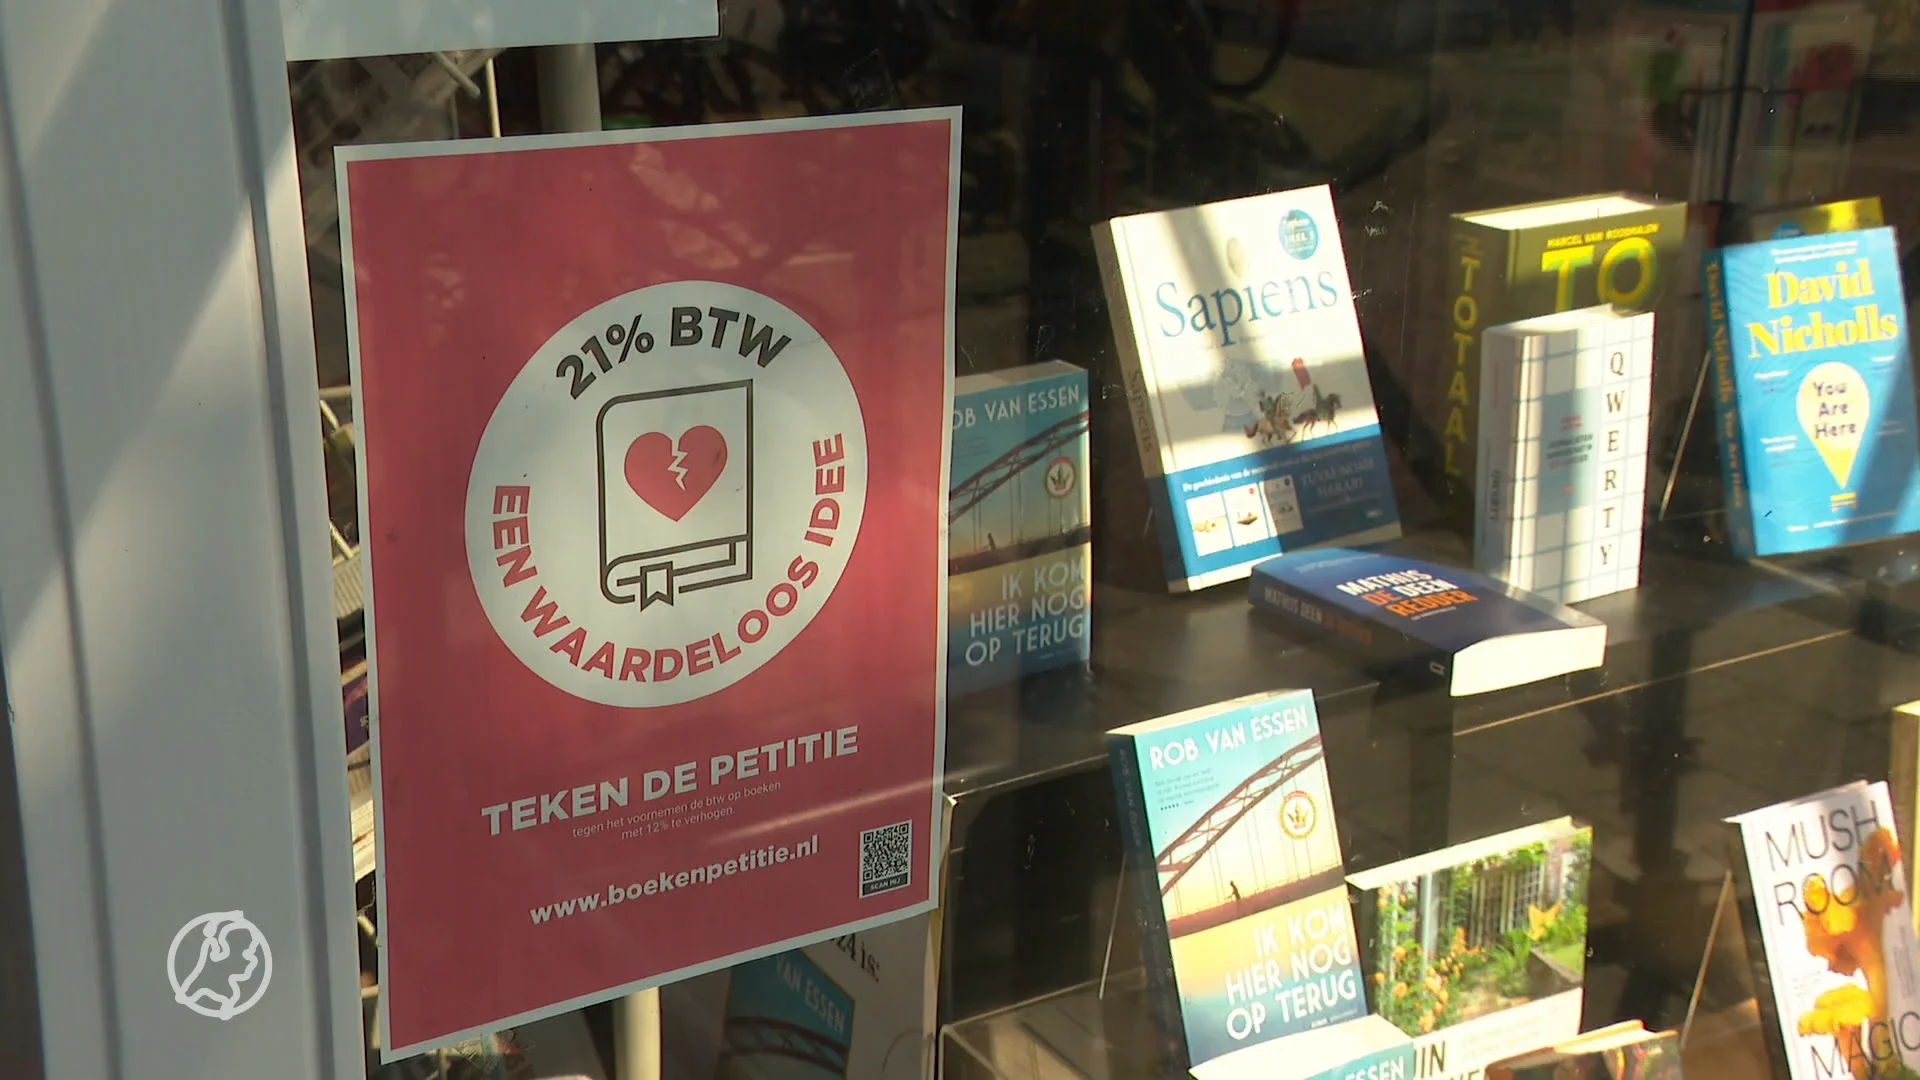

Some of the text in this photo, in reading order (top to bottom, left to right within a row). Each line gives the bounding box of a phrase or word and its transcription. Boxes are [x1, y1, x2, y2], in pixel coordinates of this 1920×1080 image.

[1542, 237, 1658, 312] TO
[1765, 258, 1875, 309] David
[1155, 270, 1338, 348] Sapiens
[1744, 303, 1899, 359] Nicholls
[555, 306, 793, 400] 21% BTW
[1445, 255, 1482, 477] TOTAAL
[953, 384, 1081, 430] OB VAN ESSEN
[1812, 381, 1847, 397] You
[1819, 402, 1848, 418] Are
[1600, 351, 1627, 566] QWERTY
[1814, 422, 1856, 439] Here
[492, 433, 845, 683] EEN WAARDELOOS IDEE
[1002, 556, 1084, 600] IK KOM
[1392, 578, 1460, 597] DEEN
[970, 588, 1084, 638] HIER NOG
[1361, 589, 1406, 606] DE
[1385, 590, 1480, 617] REDDER
[965, 615, 1084, 666] OP TERUG
[1150, 704, 1309, 772] ROB VAN ESSEN
[481, 725, 859, 835] TEKEN DE PETITIE
[572, 782, 781, 838] tegen het voornemen de btw op boeken
[621, 805, 736, 840] met 12% te verhogen.
[1765, 800, 1880, 872] MUSH
[529, 834, 819, 926] www.boekenpetitie.nl
[870, 880, 890, 890] SCAN
[1774, 851, 1895, 926] ROOM
[1254, 900, 1348, 959] IK KOM
[776, 955, 845, 1035] VAN ESSEN
[1225, 936, 1351, 1005] HIER NOG
[1226, 1004, 1266, 1040] OP
[1275, 970, 1357, 1023] TERUG
[1811, 1010, 1920, 1080] MAGIC
